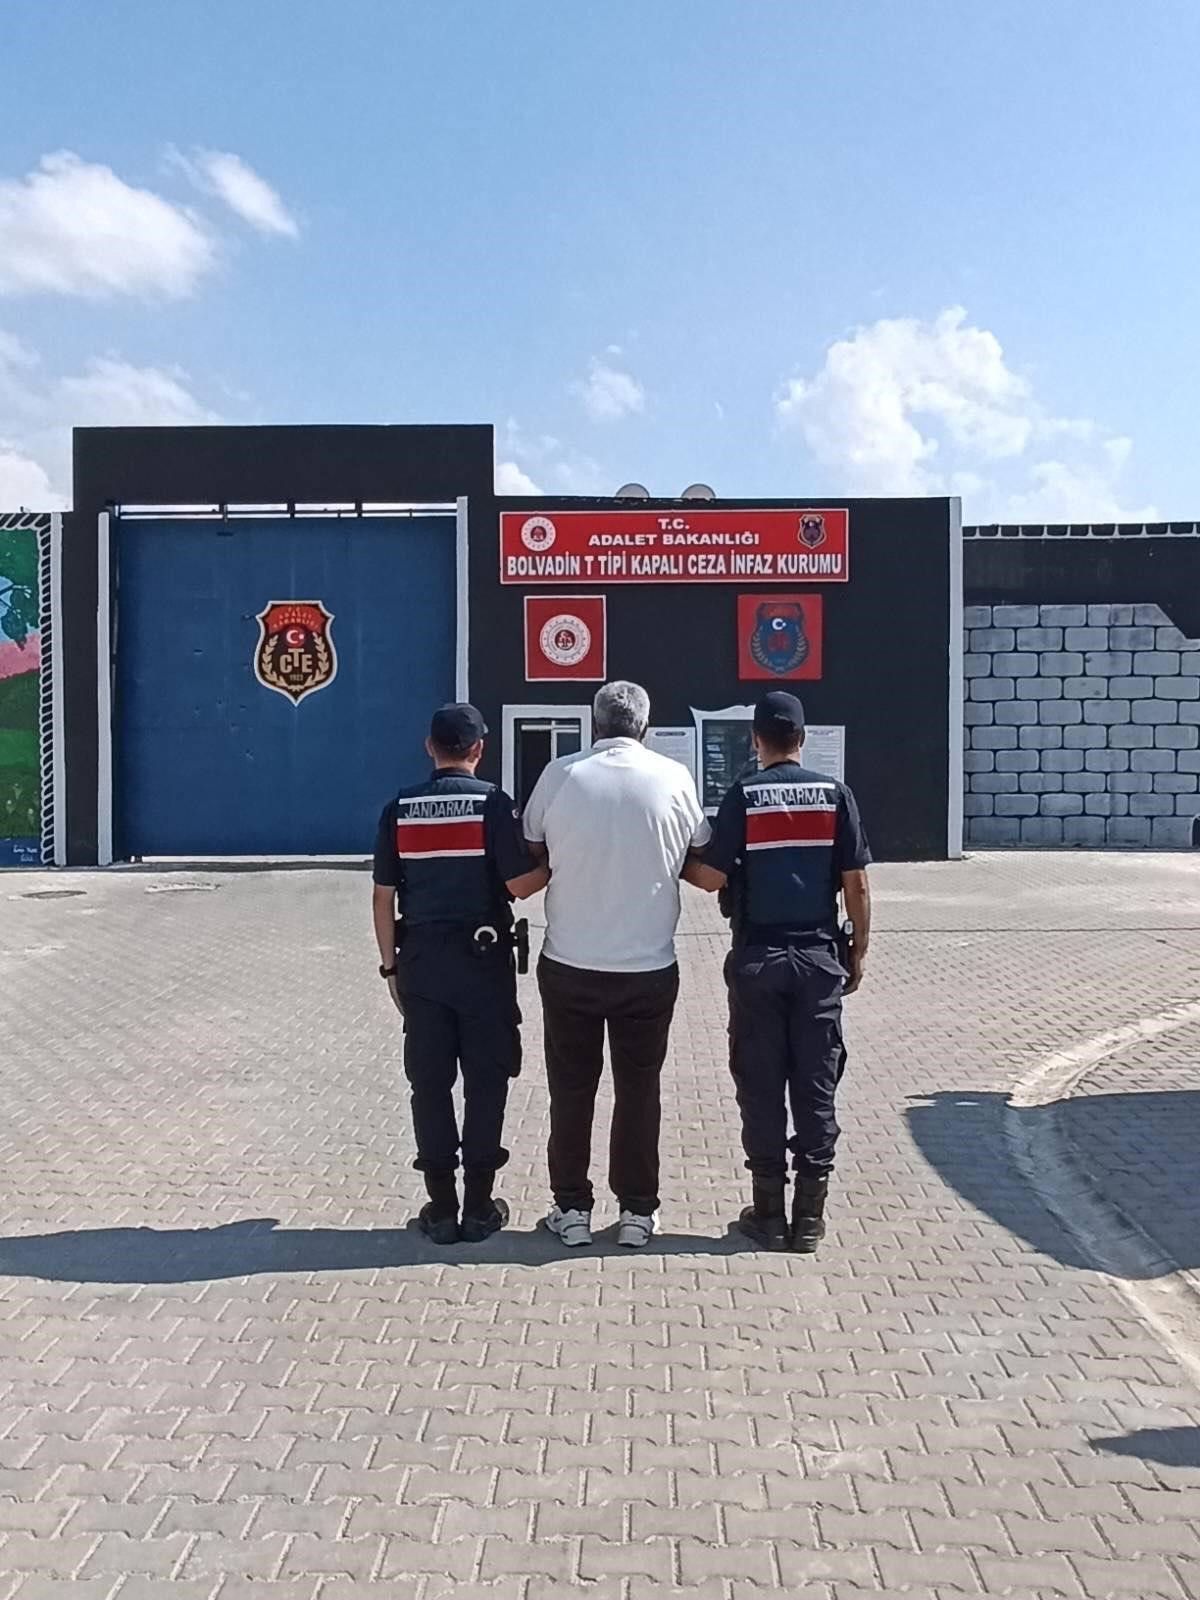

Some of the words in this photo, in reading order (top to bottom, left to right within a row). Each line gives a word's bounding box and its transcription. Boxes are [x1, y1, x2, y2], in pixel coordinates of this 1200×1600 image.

[658, 518, 690, 530] T.C.
[588, 534, 657, 546] ADALET
[662, 531, 760, 545] BAKANLIĞI
[507, 551, 581, 576] BOLVADİN
[584, 555, 595, 576] T
[597, 551, 627, 576] TİPİ
[631, 554, 683, 576] KAPALI
[687, 554, 727, 575] CEZA
[730, 549, 774, 575] İNFAZ
[777, 553, 842, 575] KURUMU
[279, 648, 313, 673] CTE
[752, 786, 829, 807] JANDARMA
[404, 799, 475, 819] JANDARMA
